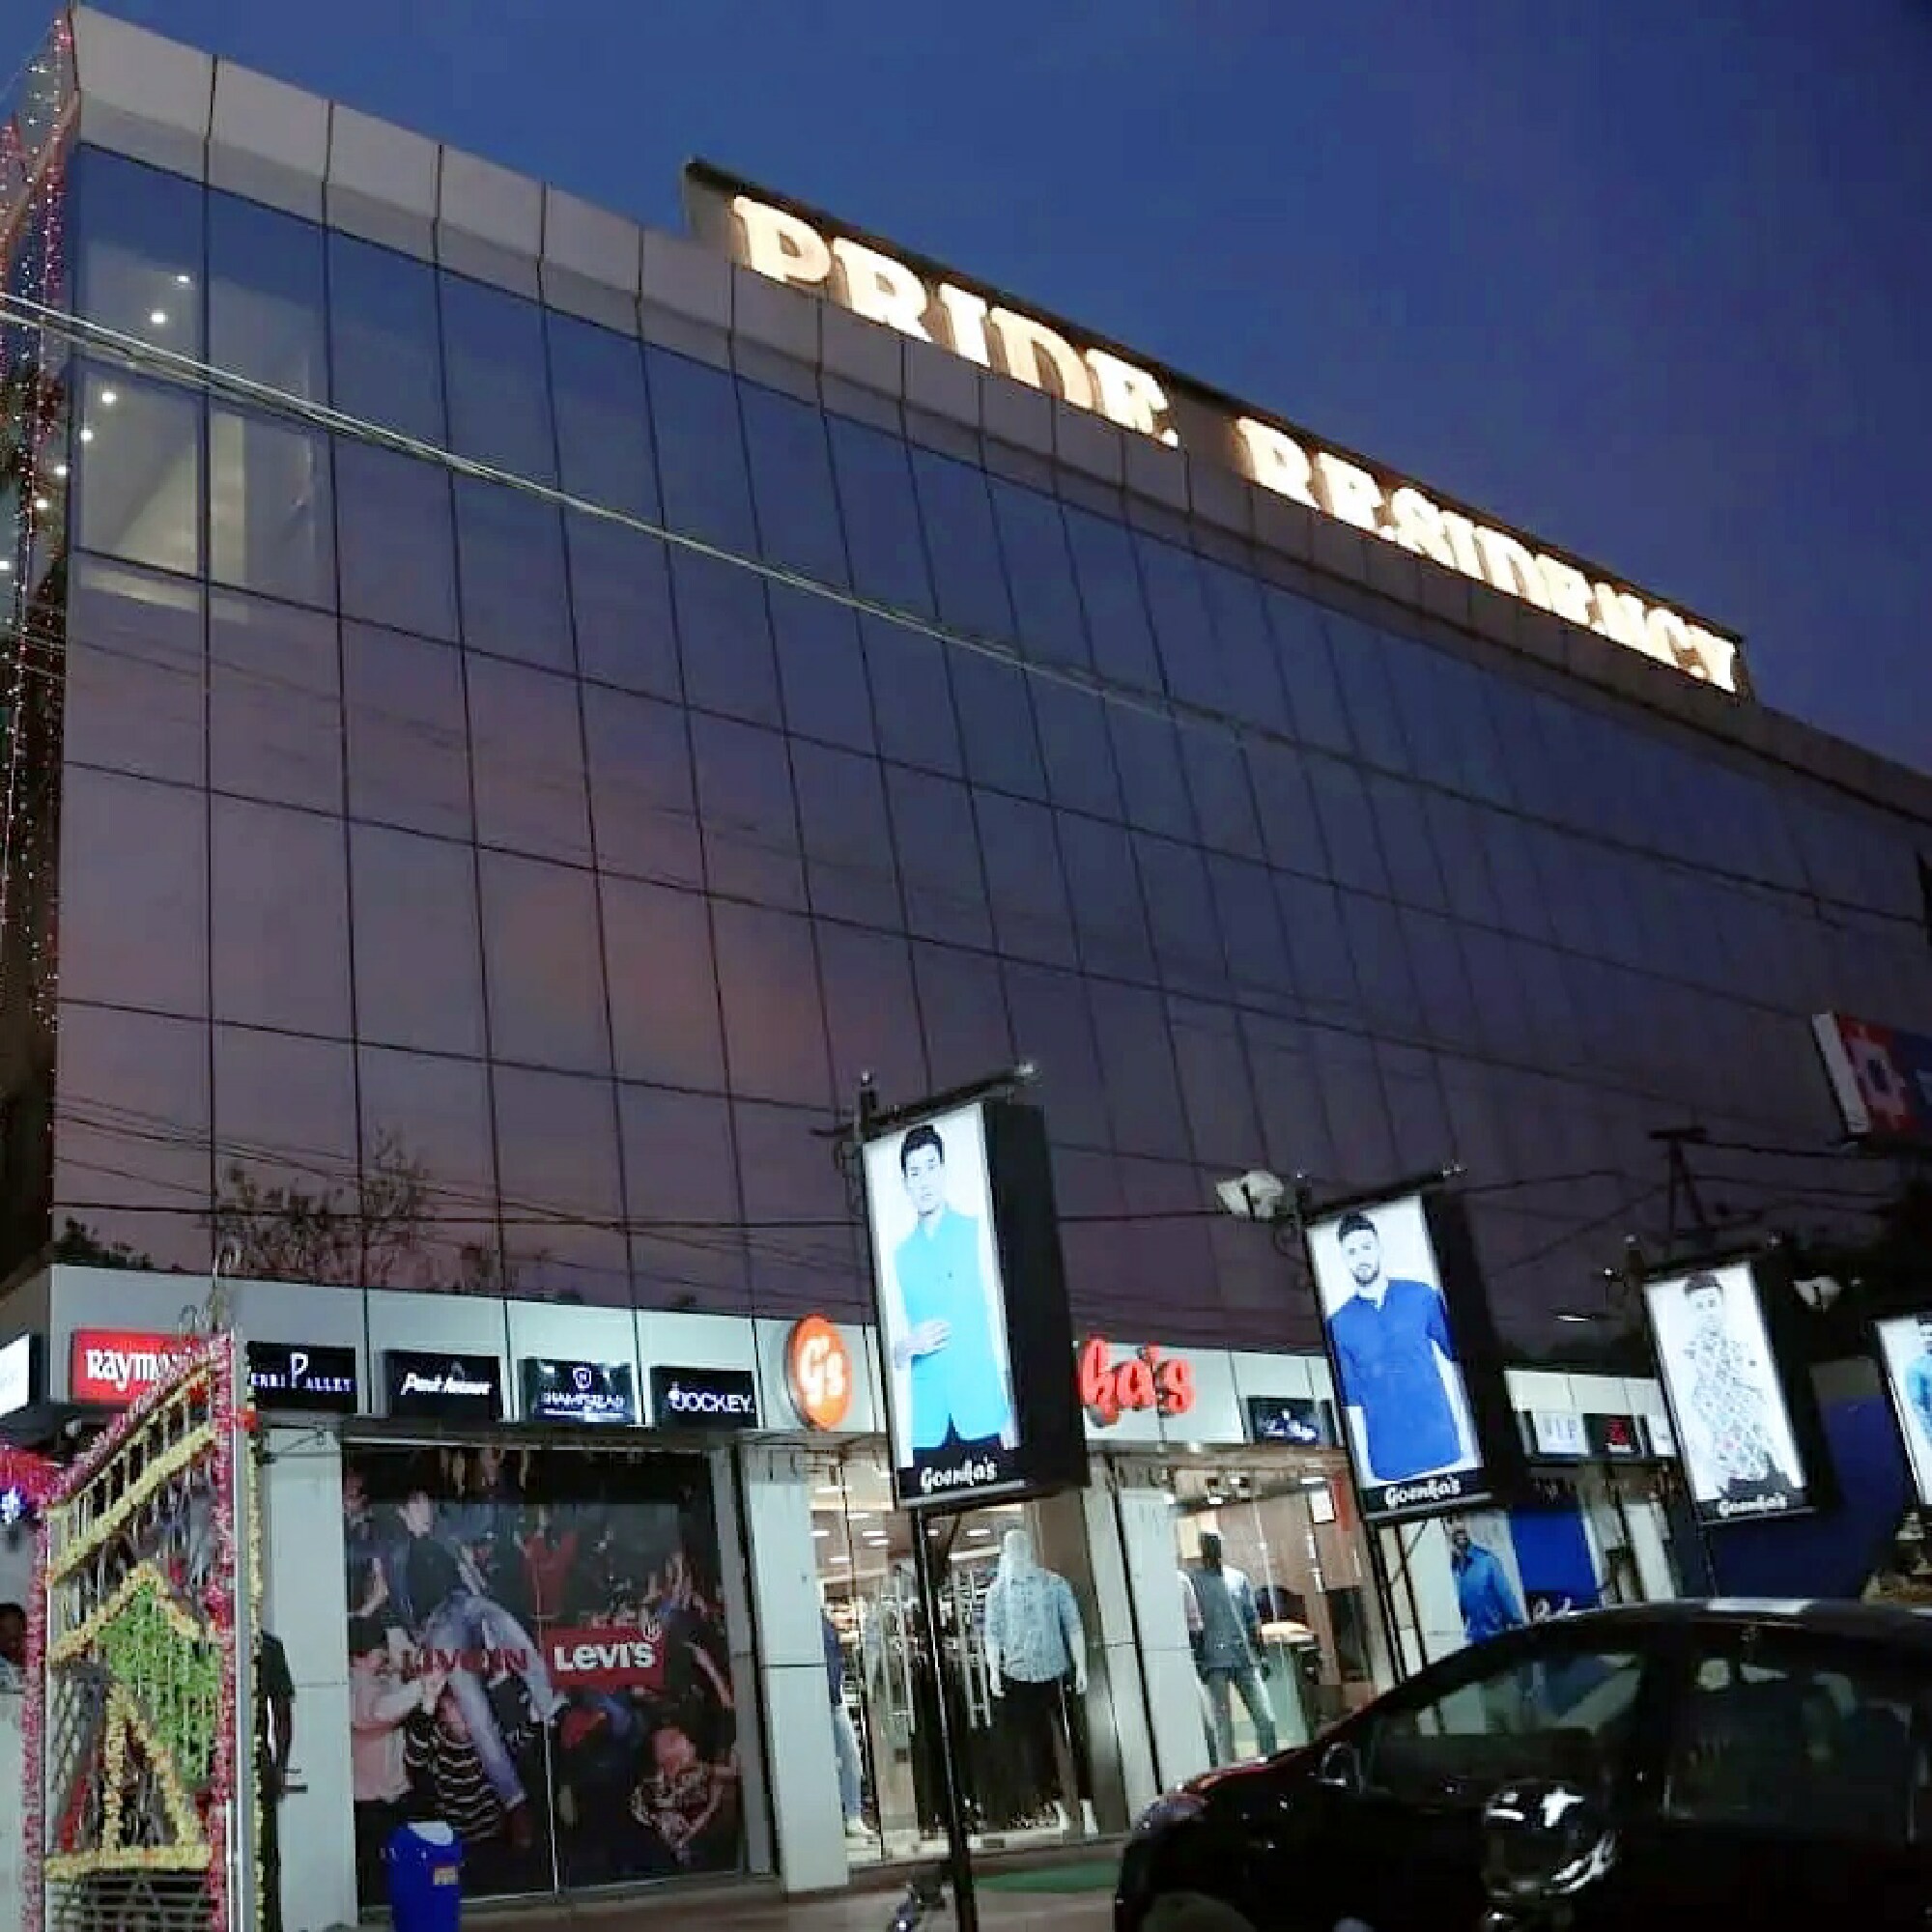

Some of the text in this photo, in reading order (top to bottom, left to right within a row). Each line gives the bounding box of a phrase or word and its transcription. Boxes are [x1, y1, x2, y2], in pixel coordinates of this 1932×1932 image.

[732, 195, 1737, 694] PRIDE RESIDENCY
[671, 1392, 753, 1412] JOCKEY
